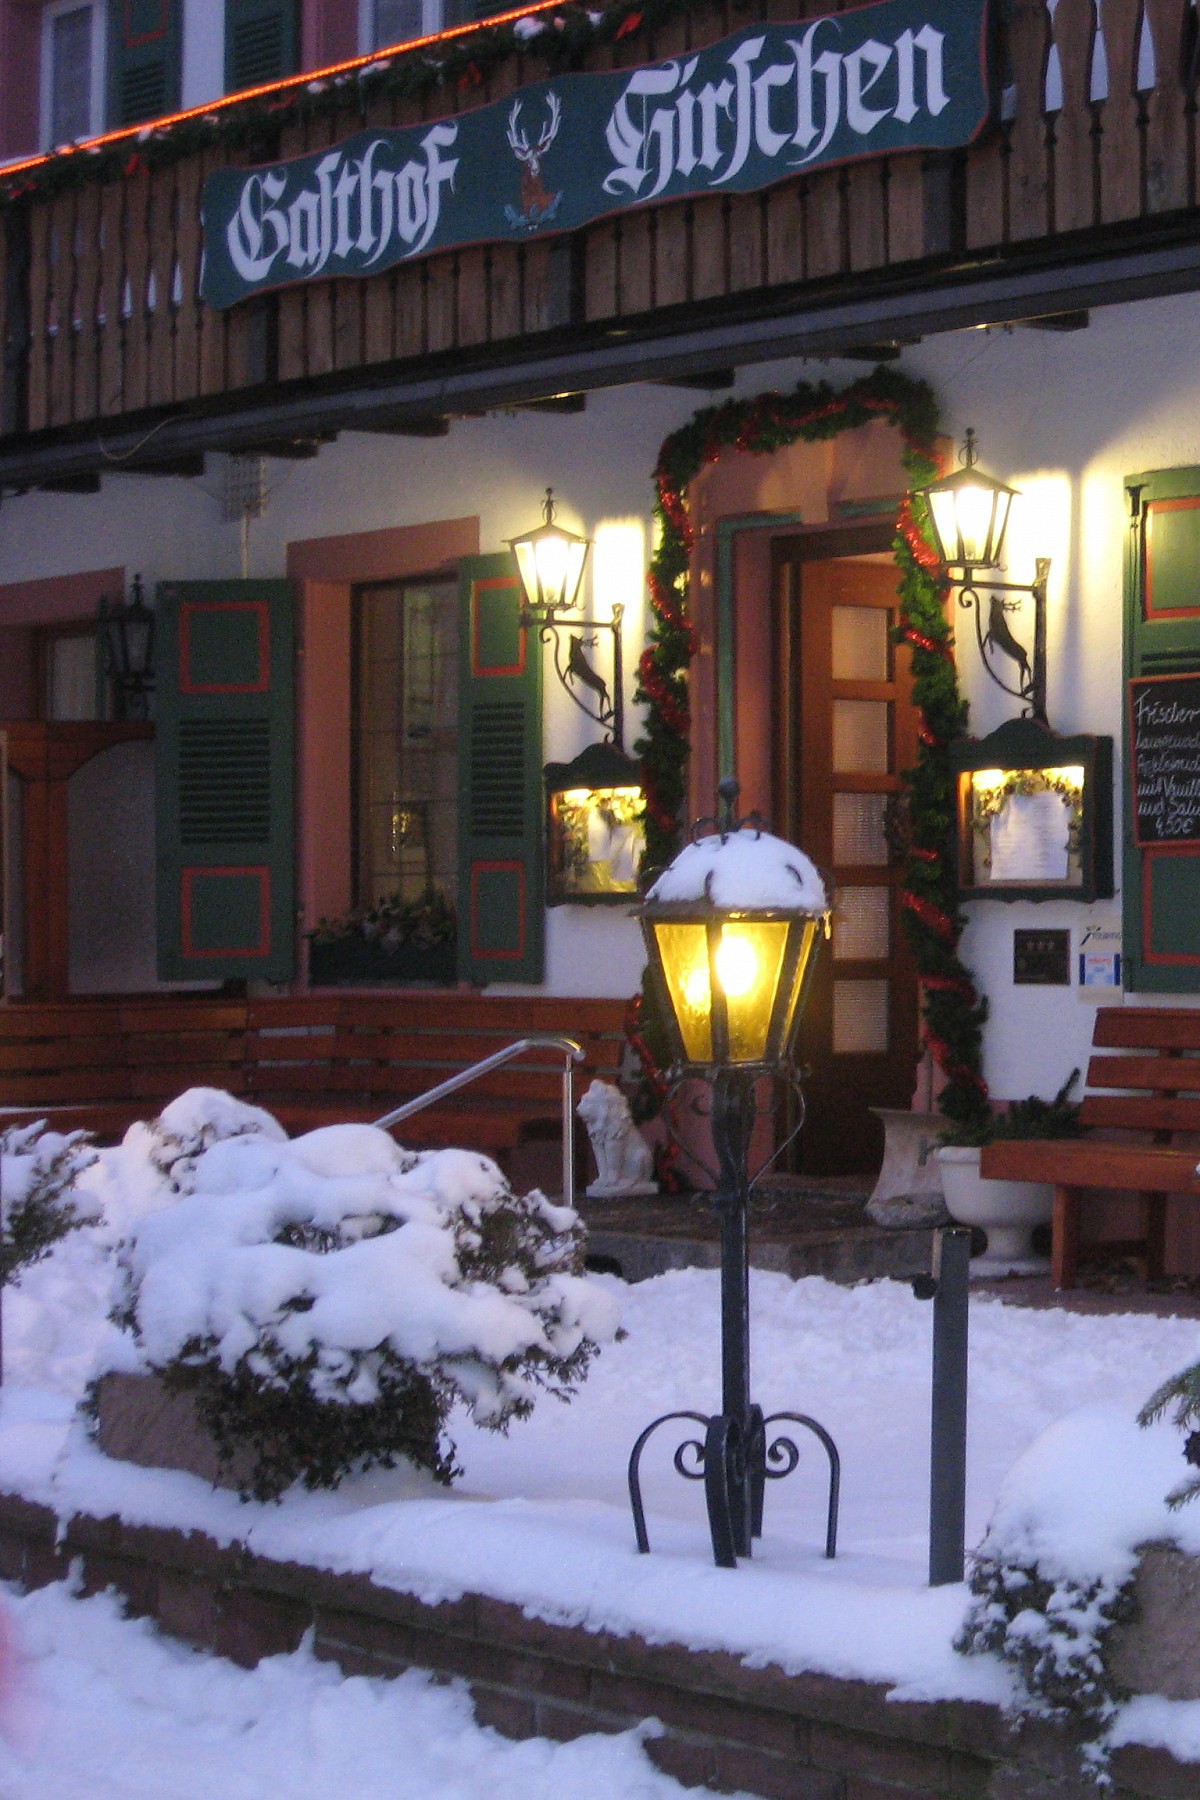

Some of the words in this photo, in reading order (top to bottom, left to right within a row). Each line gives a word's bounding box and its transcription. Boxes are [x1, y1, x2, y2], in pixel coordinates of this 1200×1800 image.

[227, 119, 460, 282] Gasthof
[602, 17, 951, 203] Hirschen
[1134, 688, 1200, 725] Frischer
